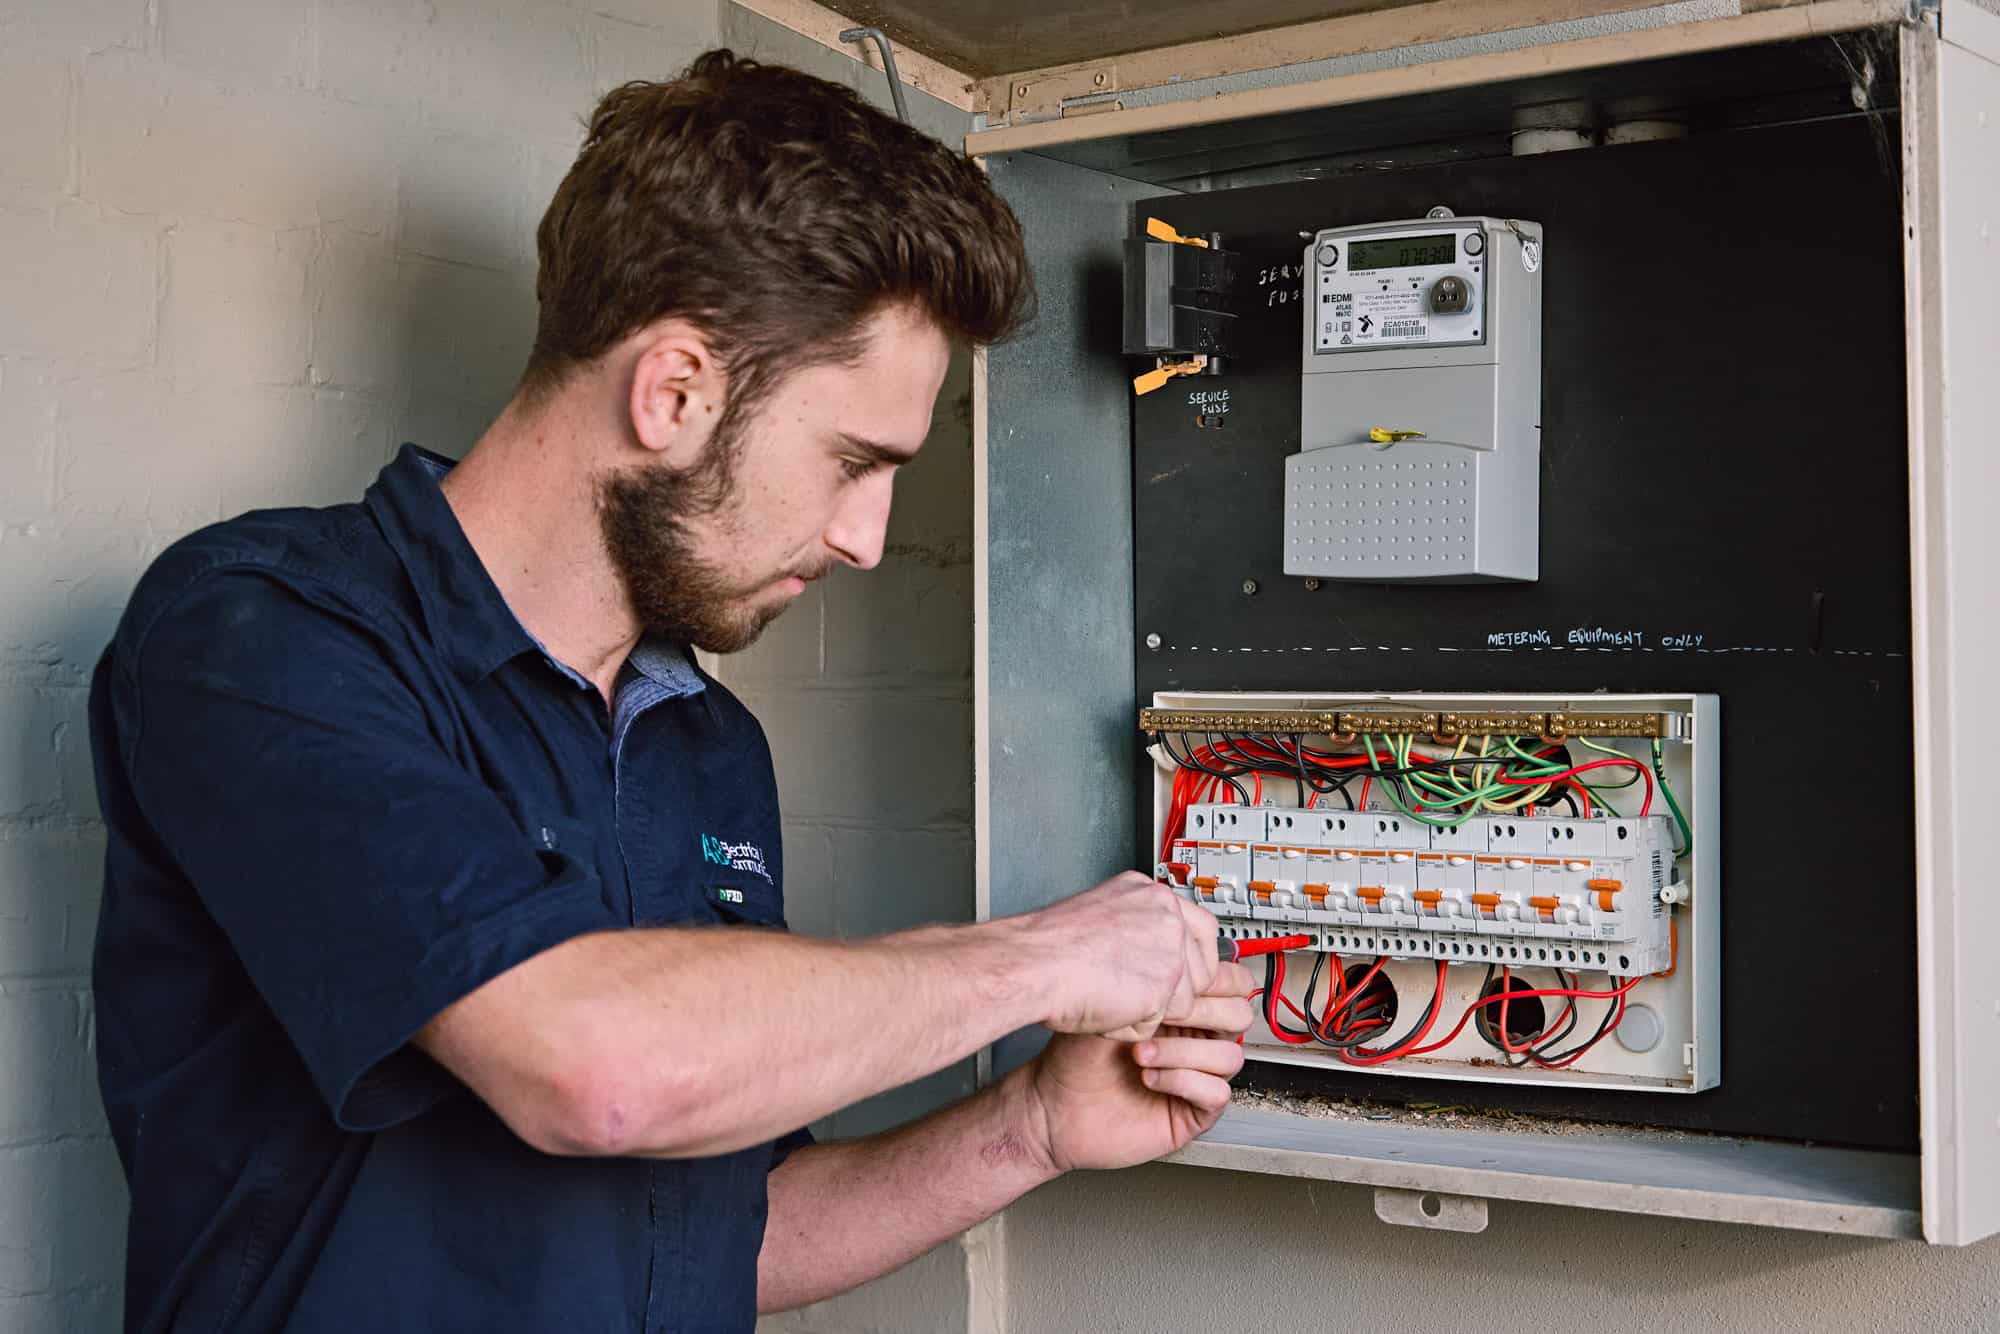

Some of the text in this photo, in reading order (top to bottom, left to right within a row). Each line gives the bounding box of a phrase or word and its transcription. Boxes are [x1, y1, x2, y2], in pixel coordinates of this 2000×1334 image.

[1268, 290, 1304, 307] FUS
[1331, 293, 1352, 303] EDMI
[1188, 390, 1230, 403] SERVICE
[1202, 402, 1230, 415] FUSE
[1487, 628, 1703, 647] METERING EQUIPMENT ONLY
